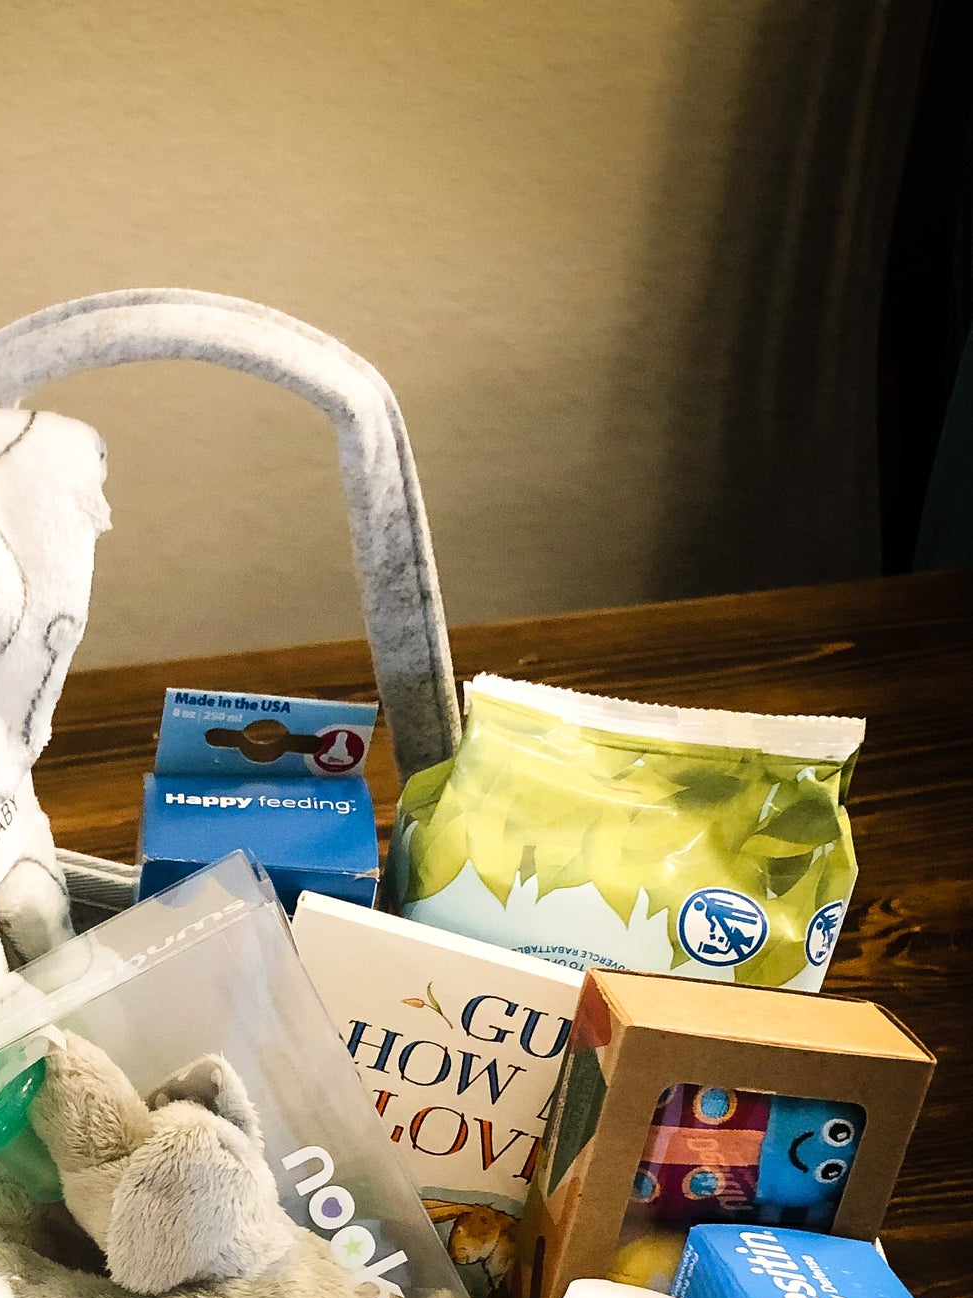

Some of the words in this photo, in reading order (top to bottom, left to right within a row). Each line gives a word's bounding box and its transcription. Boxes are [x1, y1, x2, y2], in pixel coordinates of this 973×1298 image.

[174, 692, 215, 707] Made
[218, 695, 232, 708] in
[235, 697, 258, 711] the
[261, 700, 291, 713] USA
[165, 793, 253, 809] Happy
[348, 1019, 527, 1105] HOW
